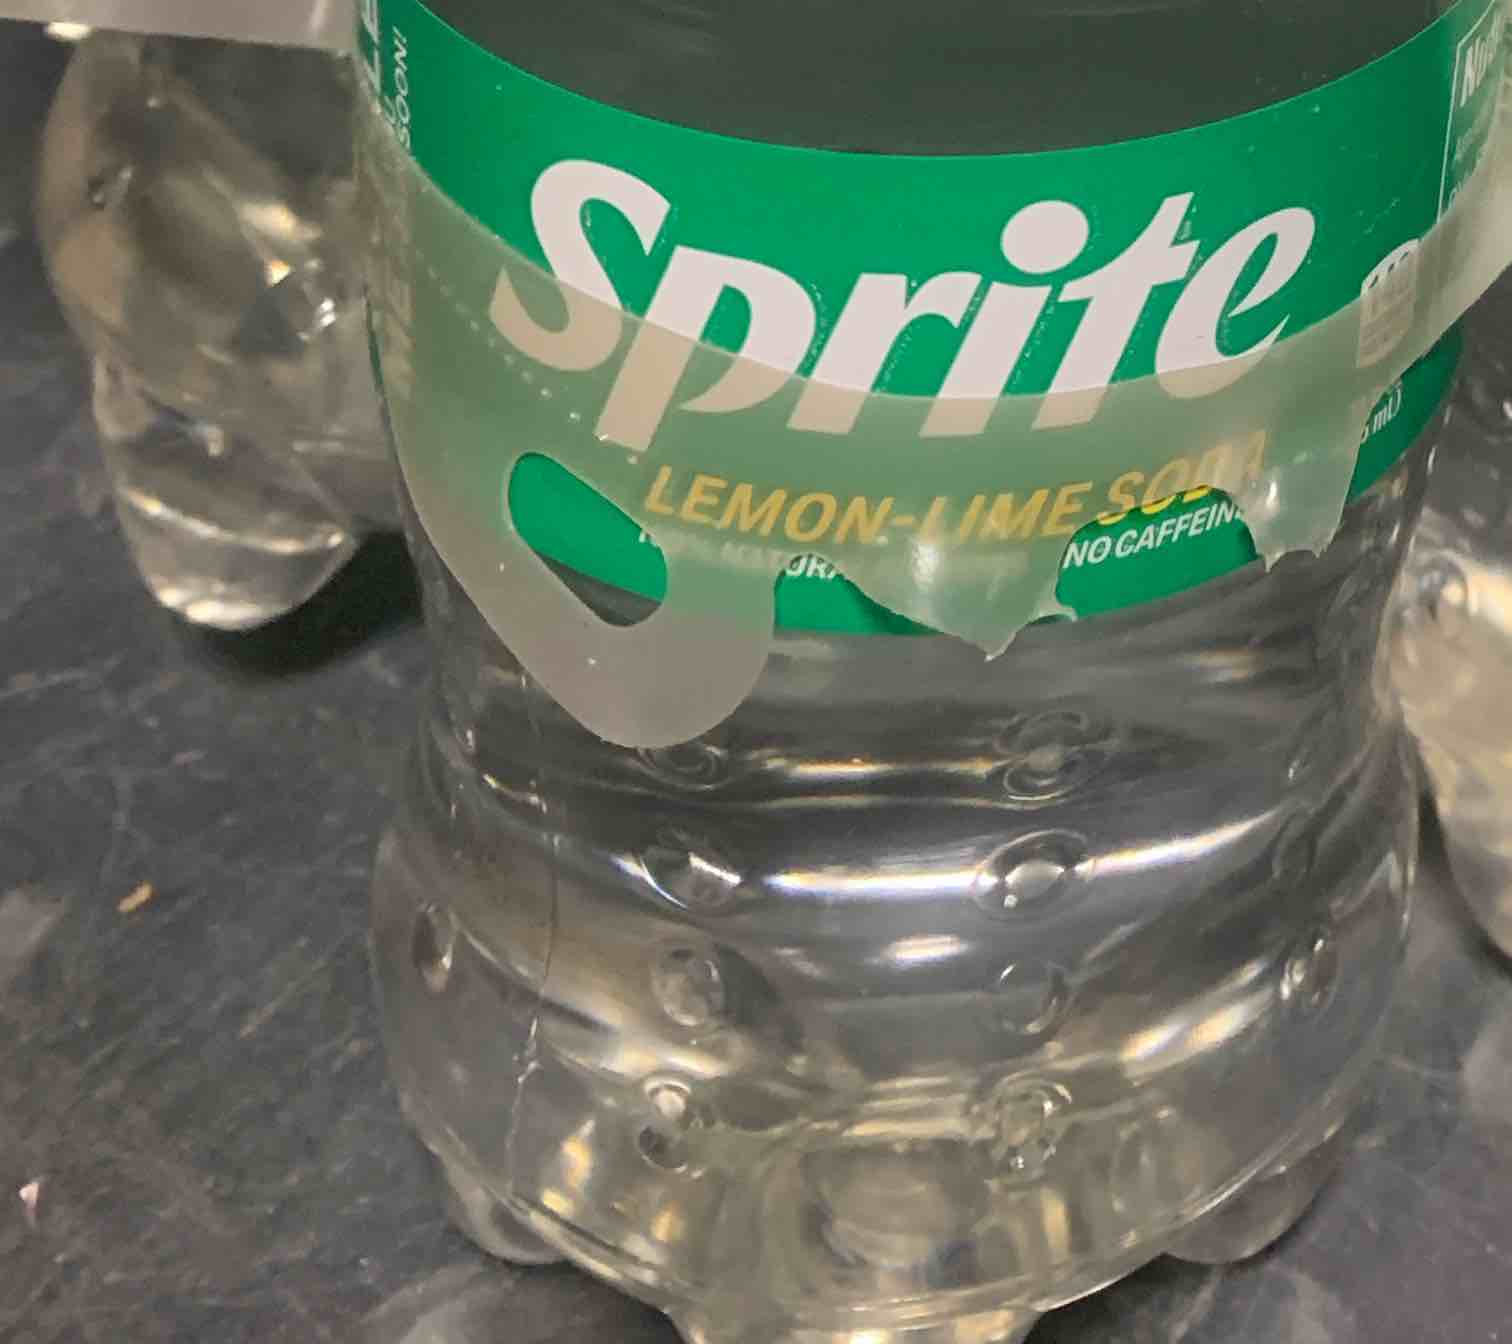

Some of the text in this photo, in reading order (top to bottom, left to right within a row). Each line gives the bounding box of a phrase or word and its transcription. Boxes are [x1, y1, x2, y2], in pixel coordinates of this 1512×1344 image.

[488, 158, 1316, 453] Sprite
[644, 463, 1094, 545] LEMON-LIME
[1062, 500, 1243, 569] NO CAFFEIN
